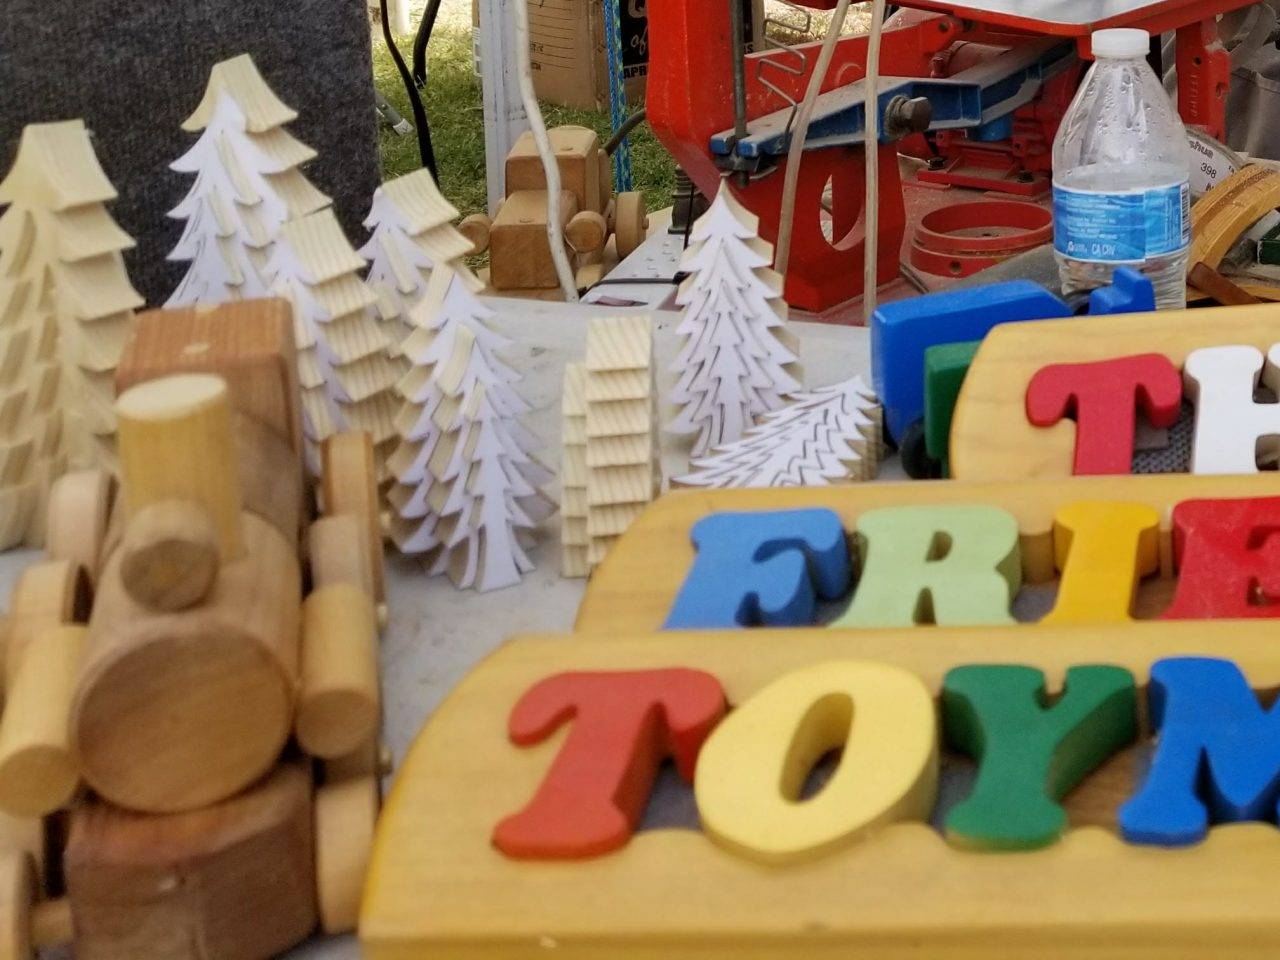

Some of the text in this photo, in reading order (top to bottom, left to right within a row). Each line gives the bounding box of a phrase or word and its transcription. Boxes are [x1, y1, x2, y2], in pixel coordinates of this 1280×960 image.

[623, 65, 648, 79] APR
[1188, 140, 1214, 159] shua
[1200, 162, 1217, 179] 398
